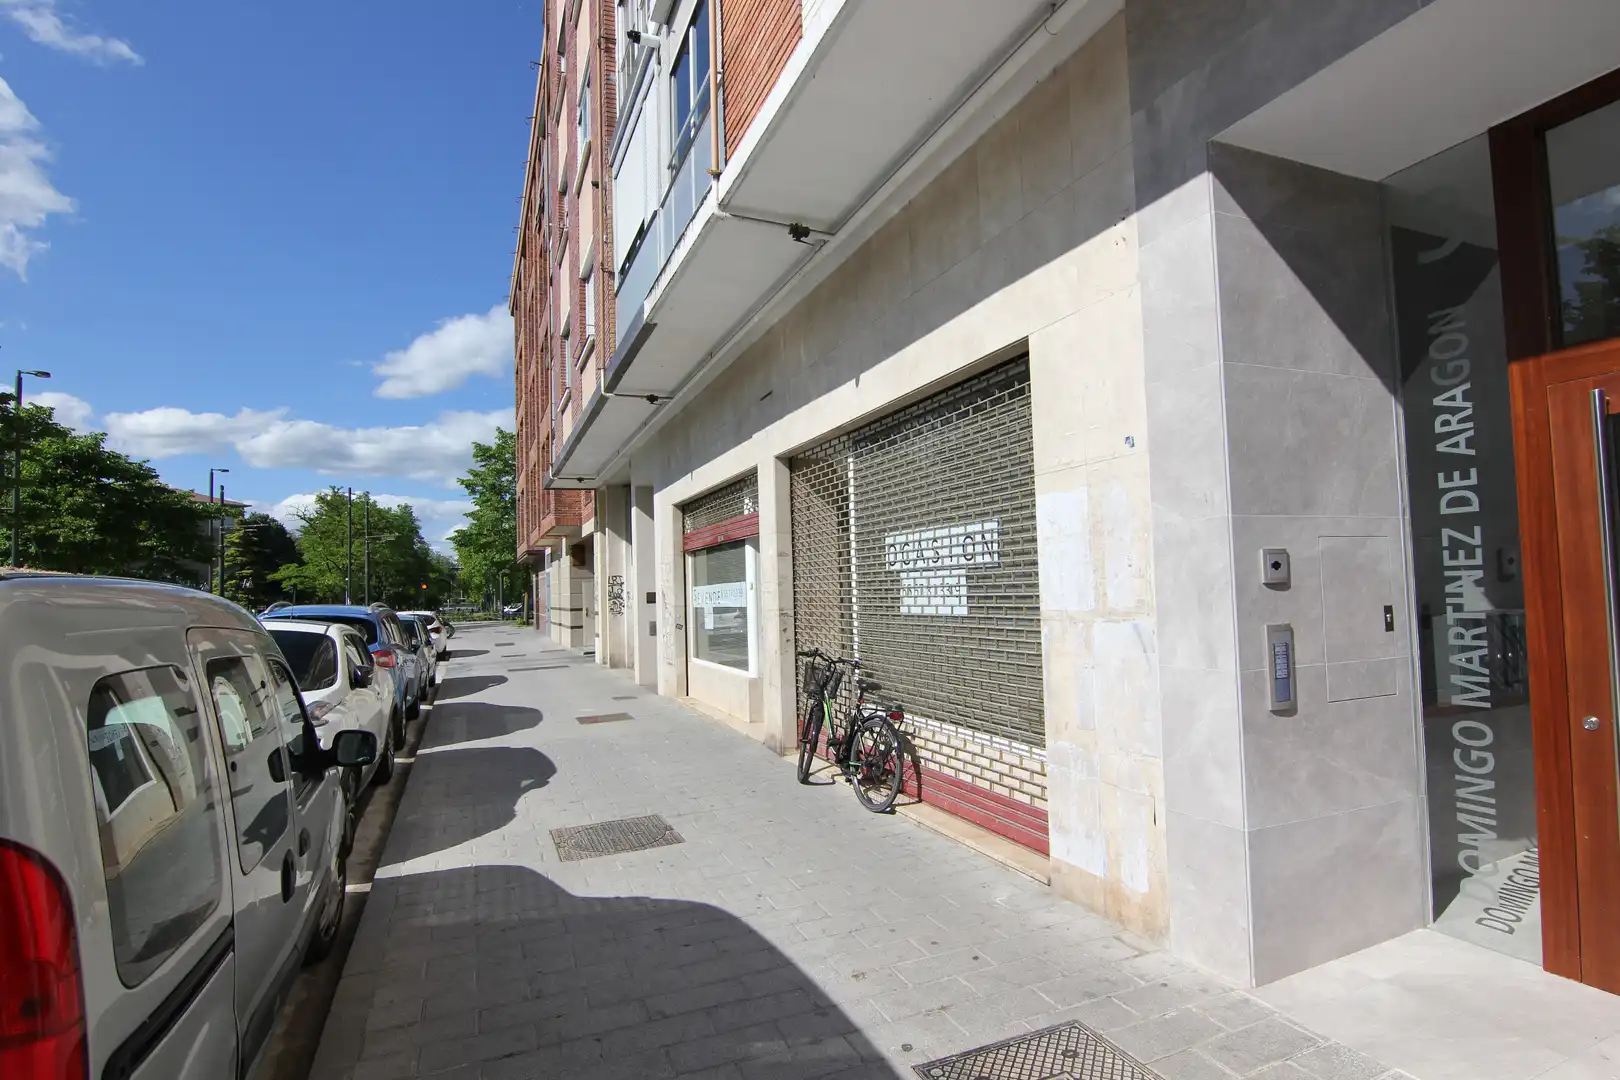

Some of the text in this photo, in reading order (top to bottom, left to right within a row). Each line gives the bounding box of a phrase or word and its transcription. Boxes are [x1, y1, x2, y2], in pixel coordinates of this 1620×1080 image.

[1427, 302, 1476, 456] ARAGON
[888, 533, 994, 567] OCASION
[1437, 467, 1480, 515] DE
[1441, 525, 1492, 709] MARTINEZ
[1451, 719, 1499, 906] DOMINGO
